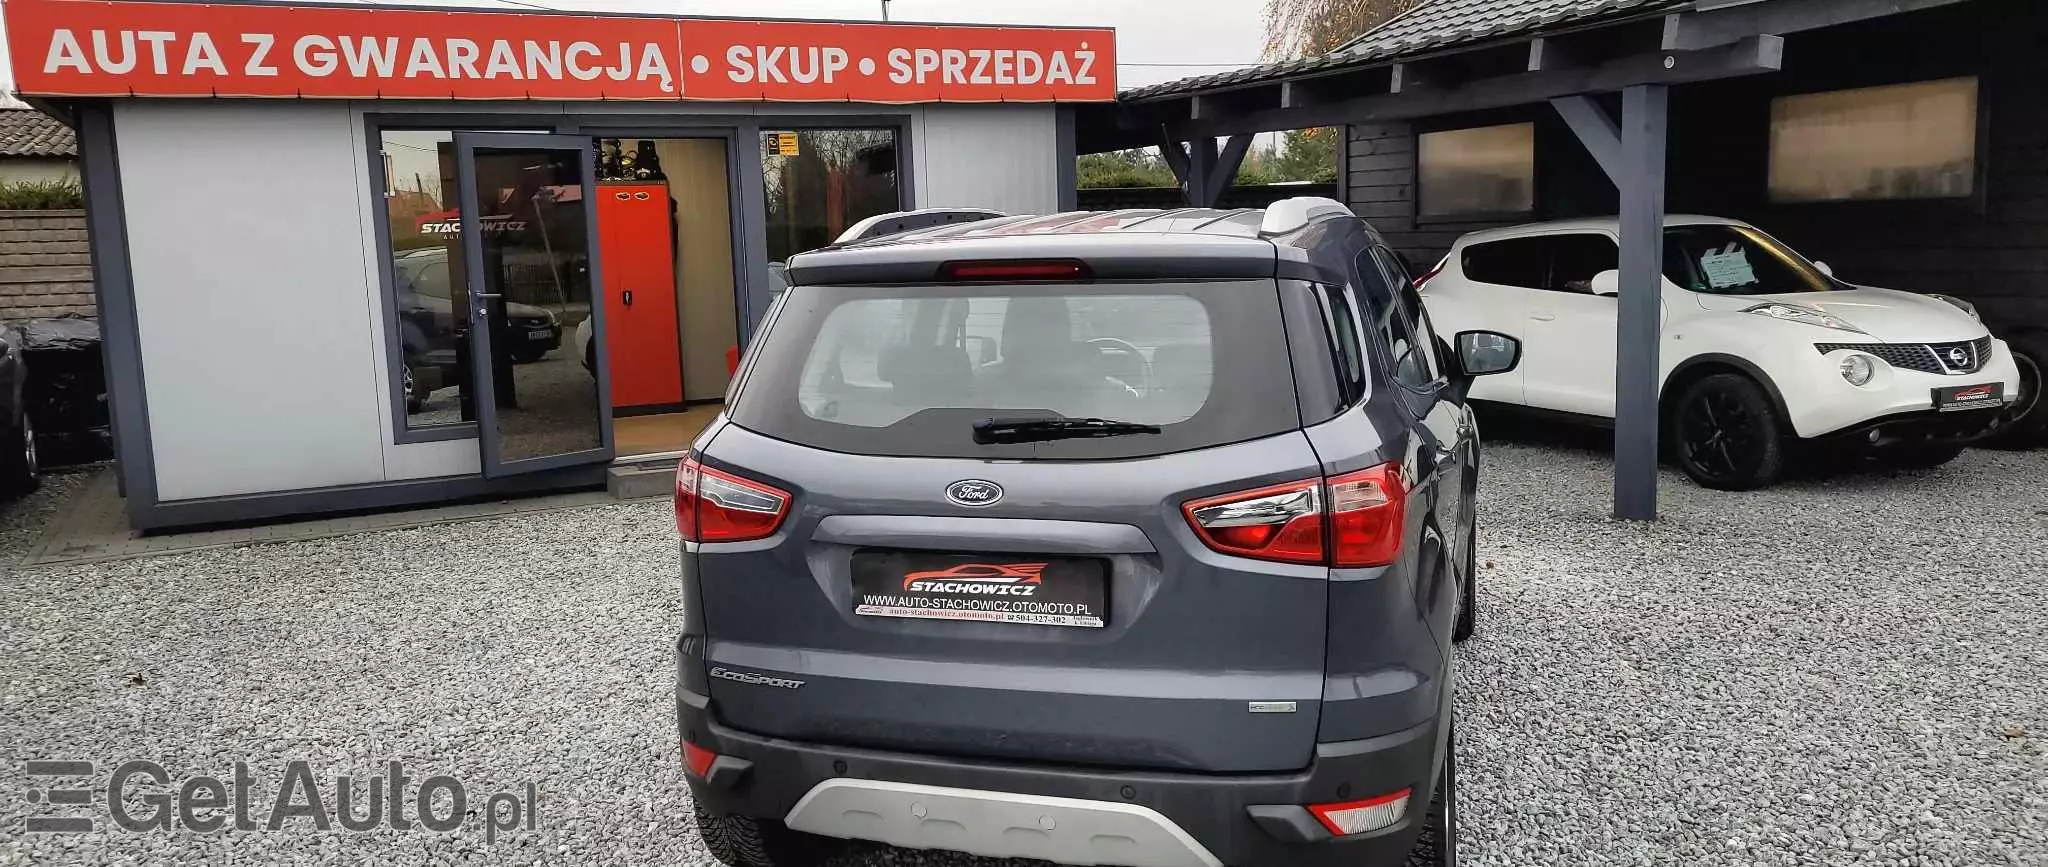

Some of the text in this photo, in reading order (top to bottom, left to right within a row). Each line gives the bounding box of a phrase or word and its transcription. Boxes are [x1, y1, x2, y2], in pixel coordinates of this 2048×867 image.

[43, 28, 1097, 92] AUTA Z GWARANCJĄ SKUP SPRZEDAŻ
[421, 221, 527, 234] STACWICZ
[958, 485, 989, 499] Ford
[910, 581, 1037, 596] STACHOWICZ
[863, 594, 1093, 615] WWW.AUTO-STACHOWICZ.OTOMOTO.PL
